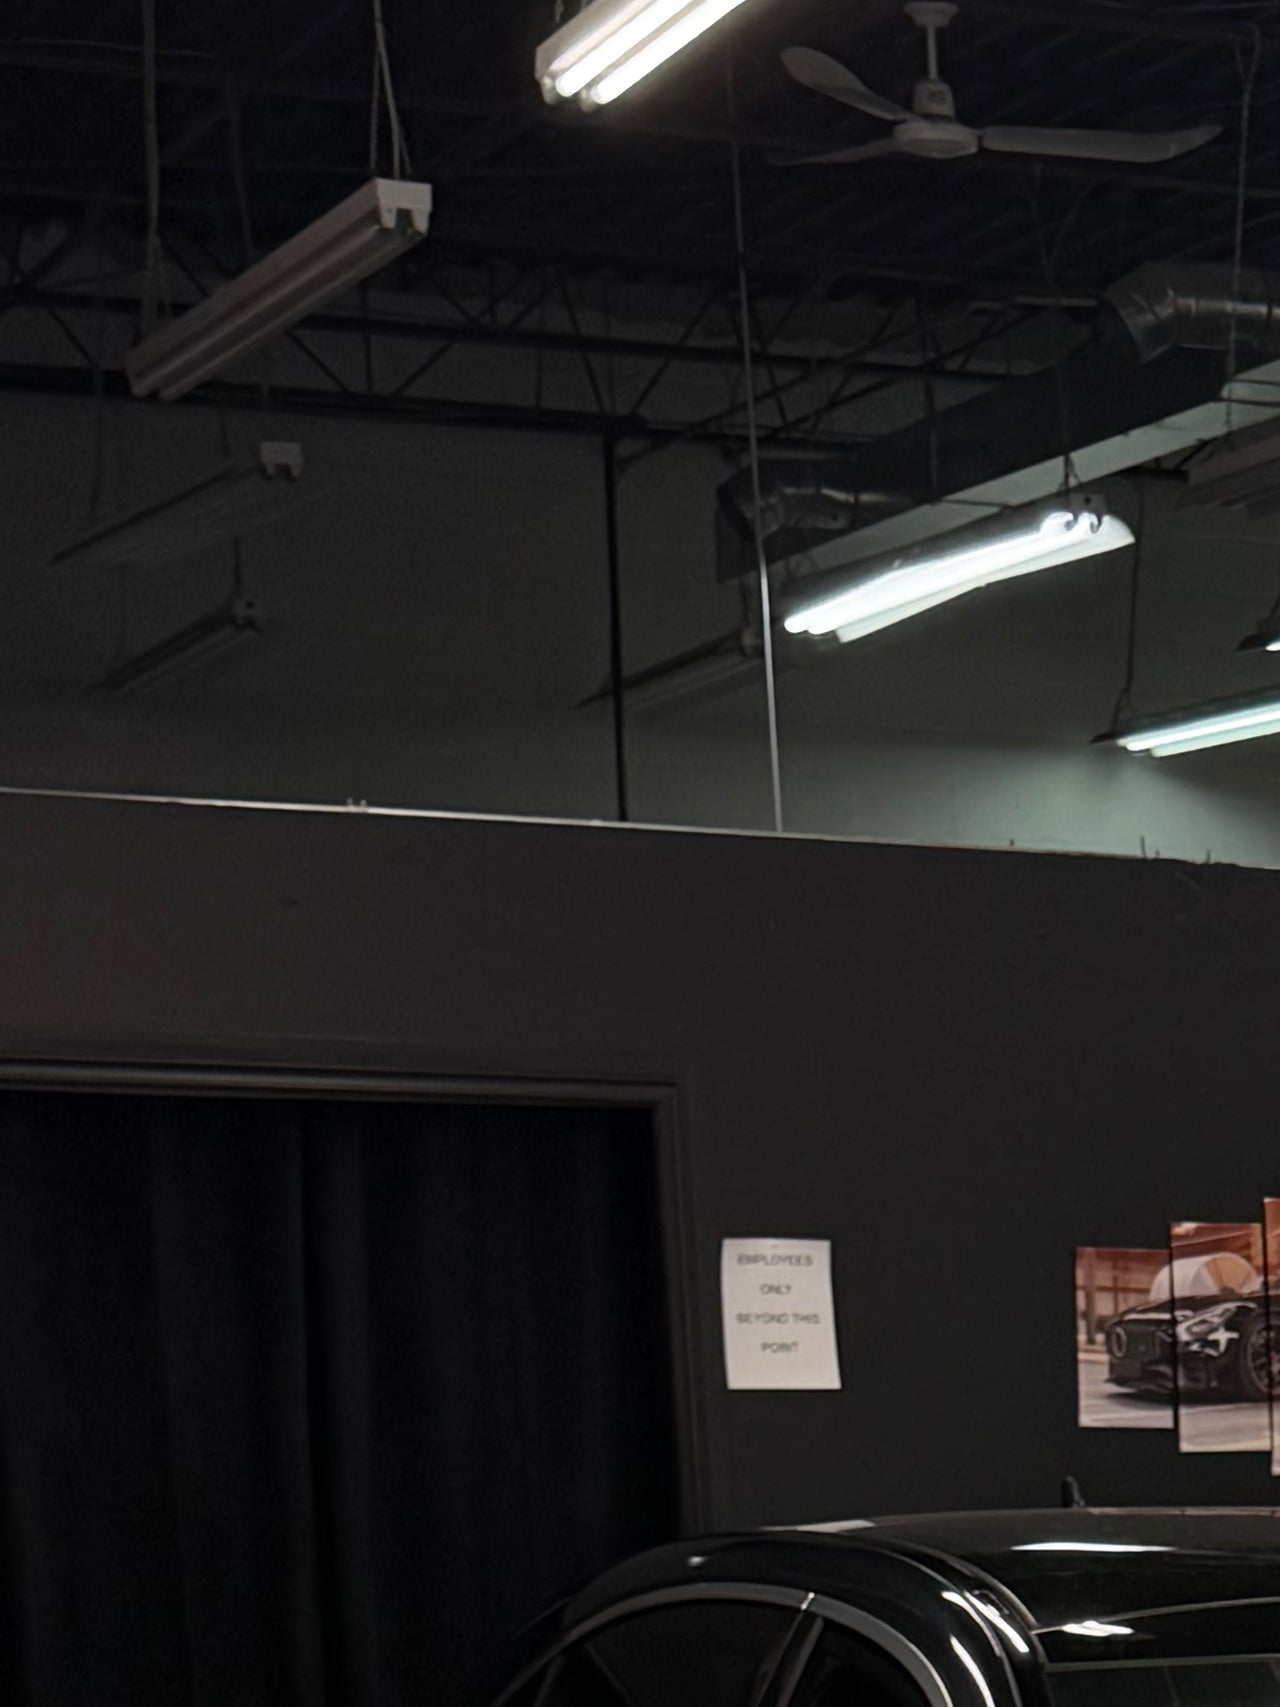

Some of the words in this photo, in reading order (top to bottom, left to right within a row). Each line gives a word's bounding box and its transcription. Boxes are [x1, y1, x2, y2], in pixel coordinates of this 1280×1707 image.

[736, 1253, 814, 1267] EMPLOYEES
[759, 1283, 792, 1295] ONLY
[735, 1312, 789, 1325] BEYOND
[791, 1313, 821, 1325] THIS
[760, 1341, 799, 1354] POINT
